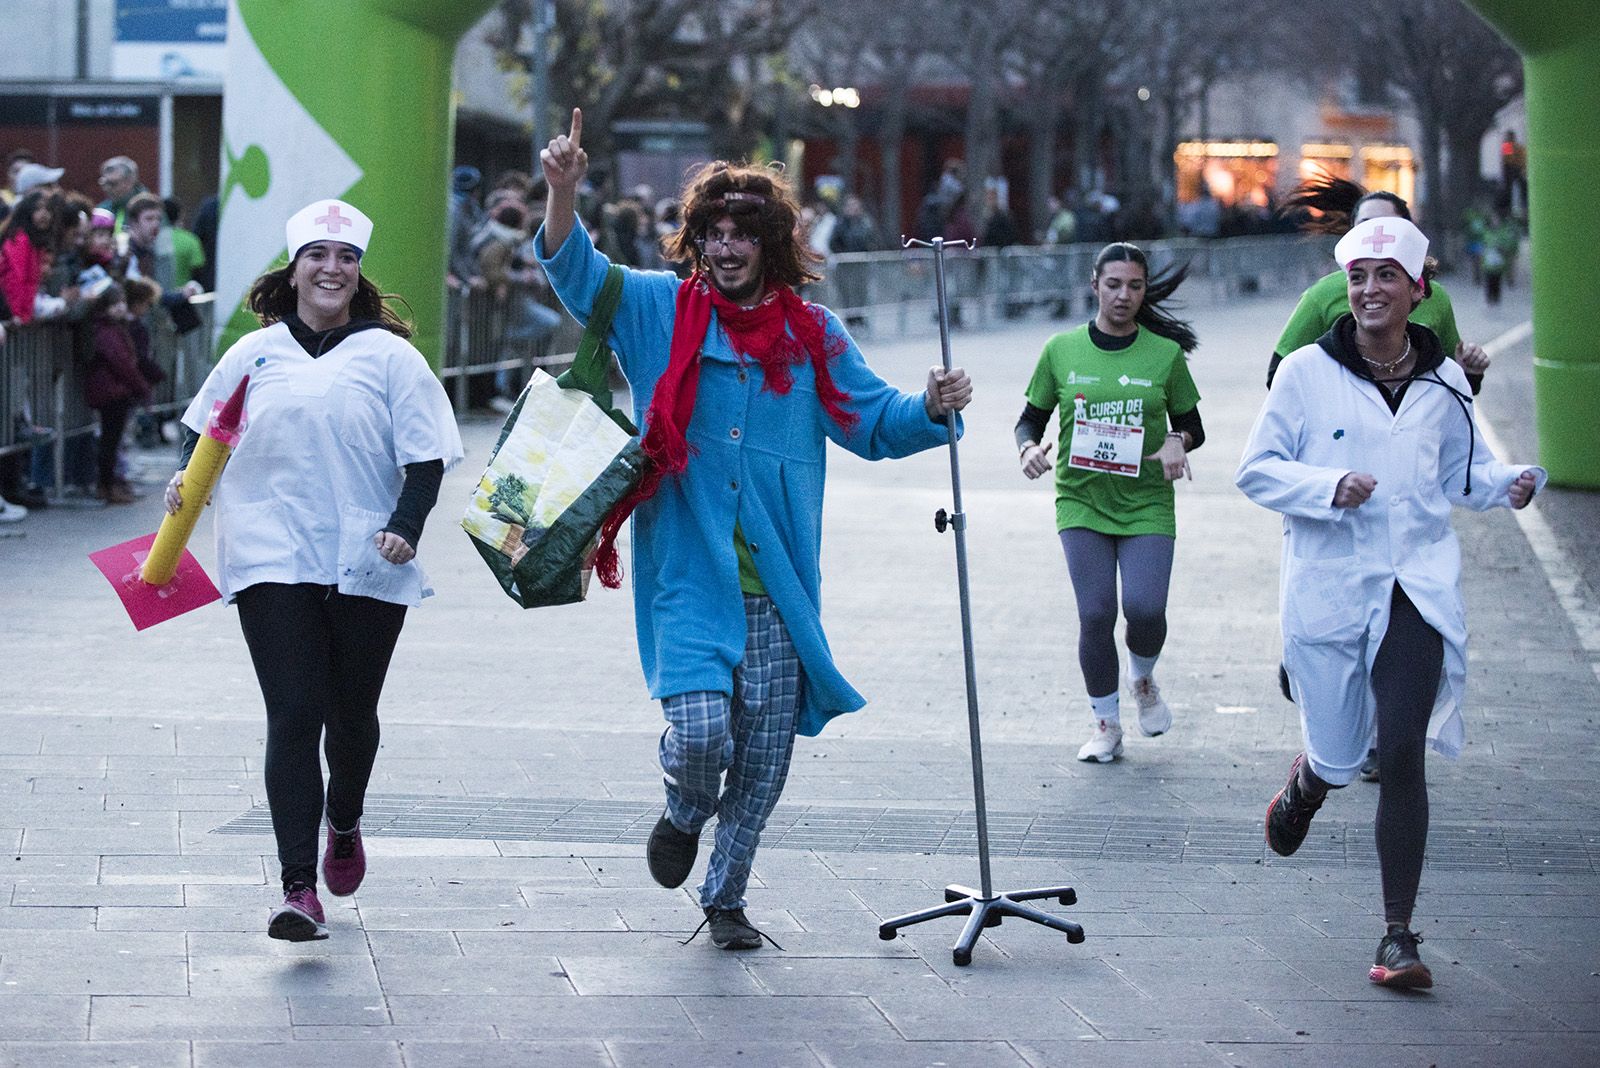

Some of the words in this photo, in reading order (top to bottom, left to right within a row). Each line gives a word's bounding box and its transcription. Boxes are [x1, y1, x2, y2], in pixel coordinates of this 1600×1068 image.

[1090, 401, 1124, 417] CURSA
[1126, 399, 1143, 413] DEL
[1098, 441, 1115, 451] ANA
[1094, 450, 1117, 460] 267
